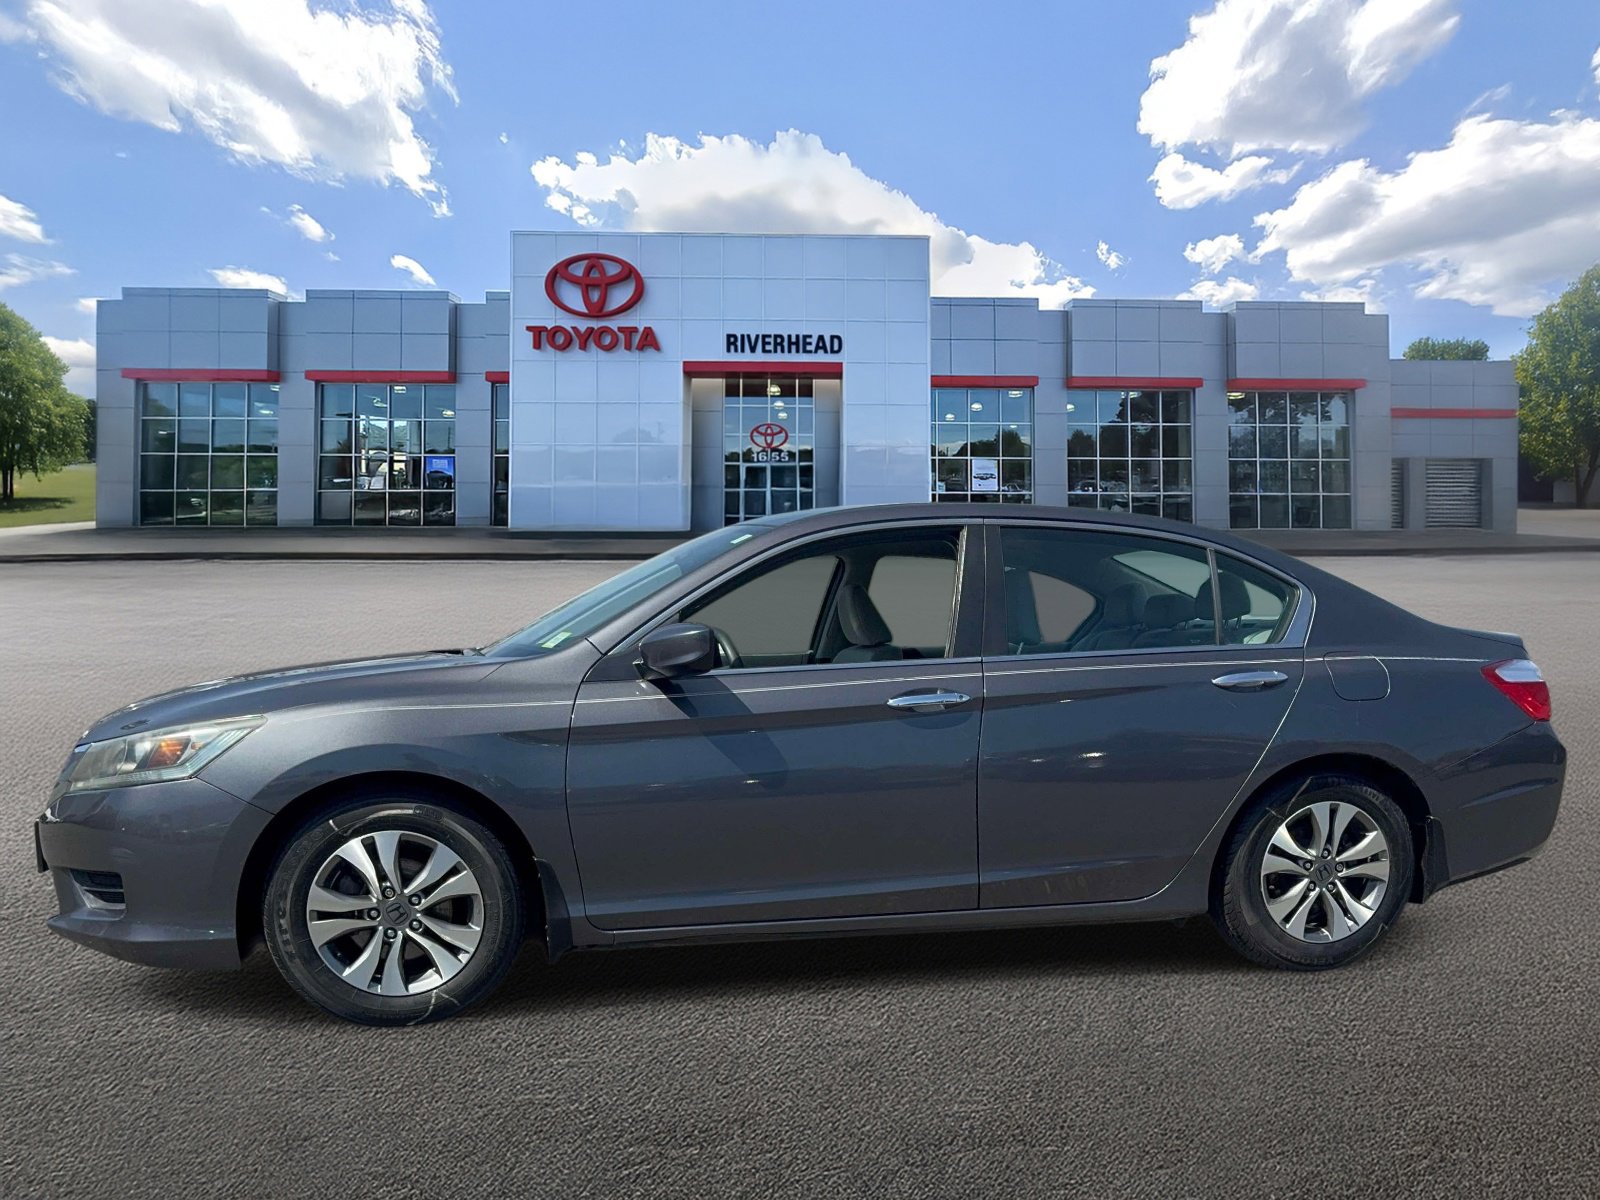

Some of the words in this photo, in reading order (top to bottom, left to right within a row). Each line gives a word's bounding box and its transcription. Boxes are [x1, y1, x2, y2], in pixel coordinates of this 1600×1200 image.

[526, 326, 661, 352] TOYOTA
[726, 334, 843, 354] RIVERHEAD
[751, 452, 789, 462] 1655
